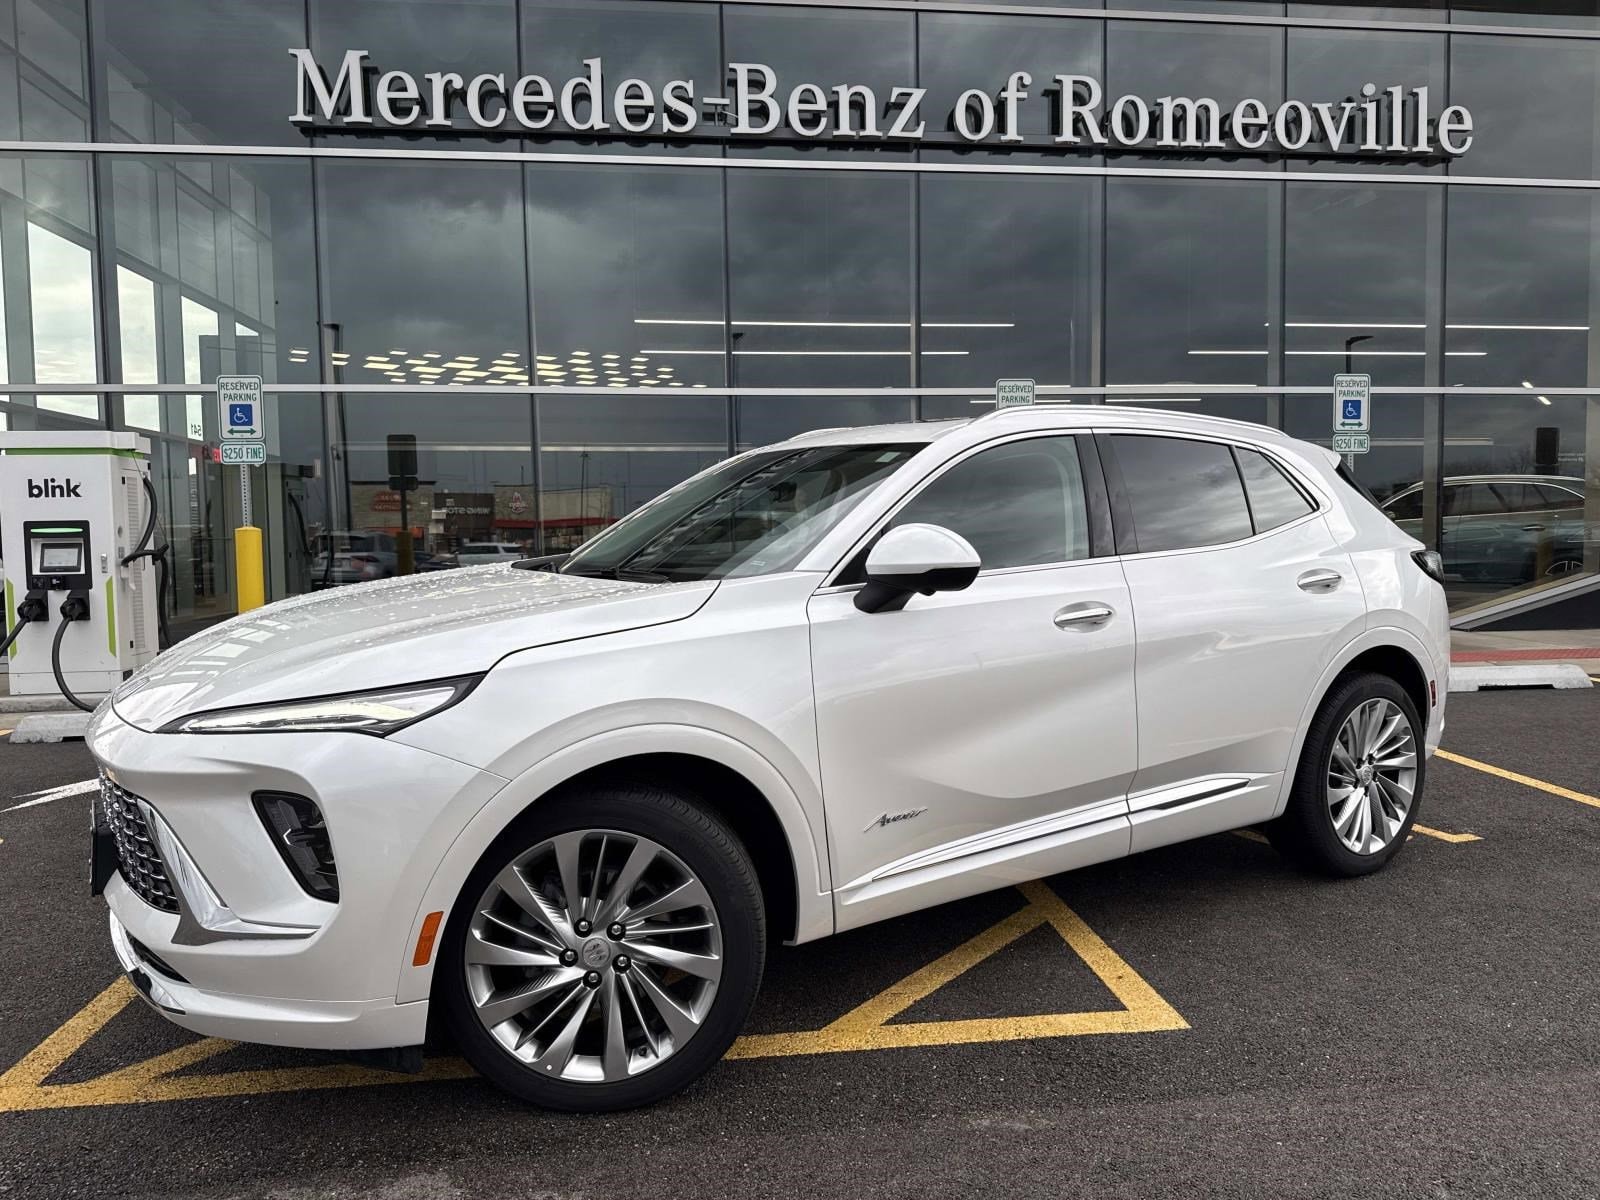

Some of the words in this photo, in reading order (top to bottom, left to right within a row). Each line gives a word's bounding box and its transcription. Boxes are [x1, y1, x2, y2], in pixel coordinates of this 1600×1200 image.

[288, 48, 927, 139] Mercedes-Benz
[955, 71, 1032, 142] of
[1054, 74, 1473, 155] Romeoville
[220, 381, 259, 391] RESERVED
[1336, 379, 1368, 388] RESERVED
[999, 385, 1033, 393] RESERVED
[223, 393, 257, 402] PARKING
[1338, 390, 1366, 398] PARKING
[1001, 395, 1030, 404] PARKING
[1335, 439, 1352, 449] $250
[1353, 439, 1367, 449] FINE
[223, 447, 244, 460] $250
[246, 447, 263, 459] FINE
[27, 478, 82, 498] blink
